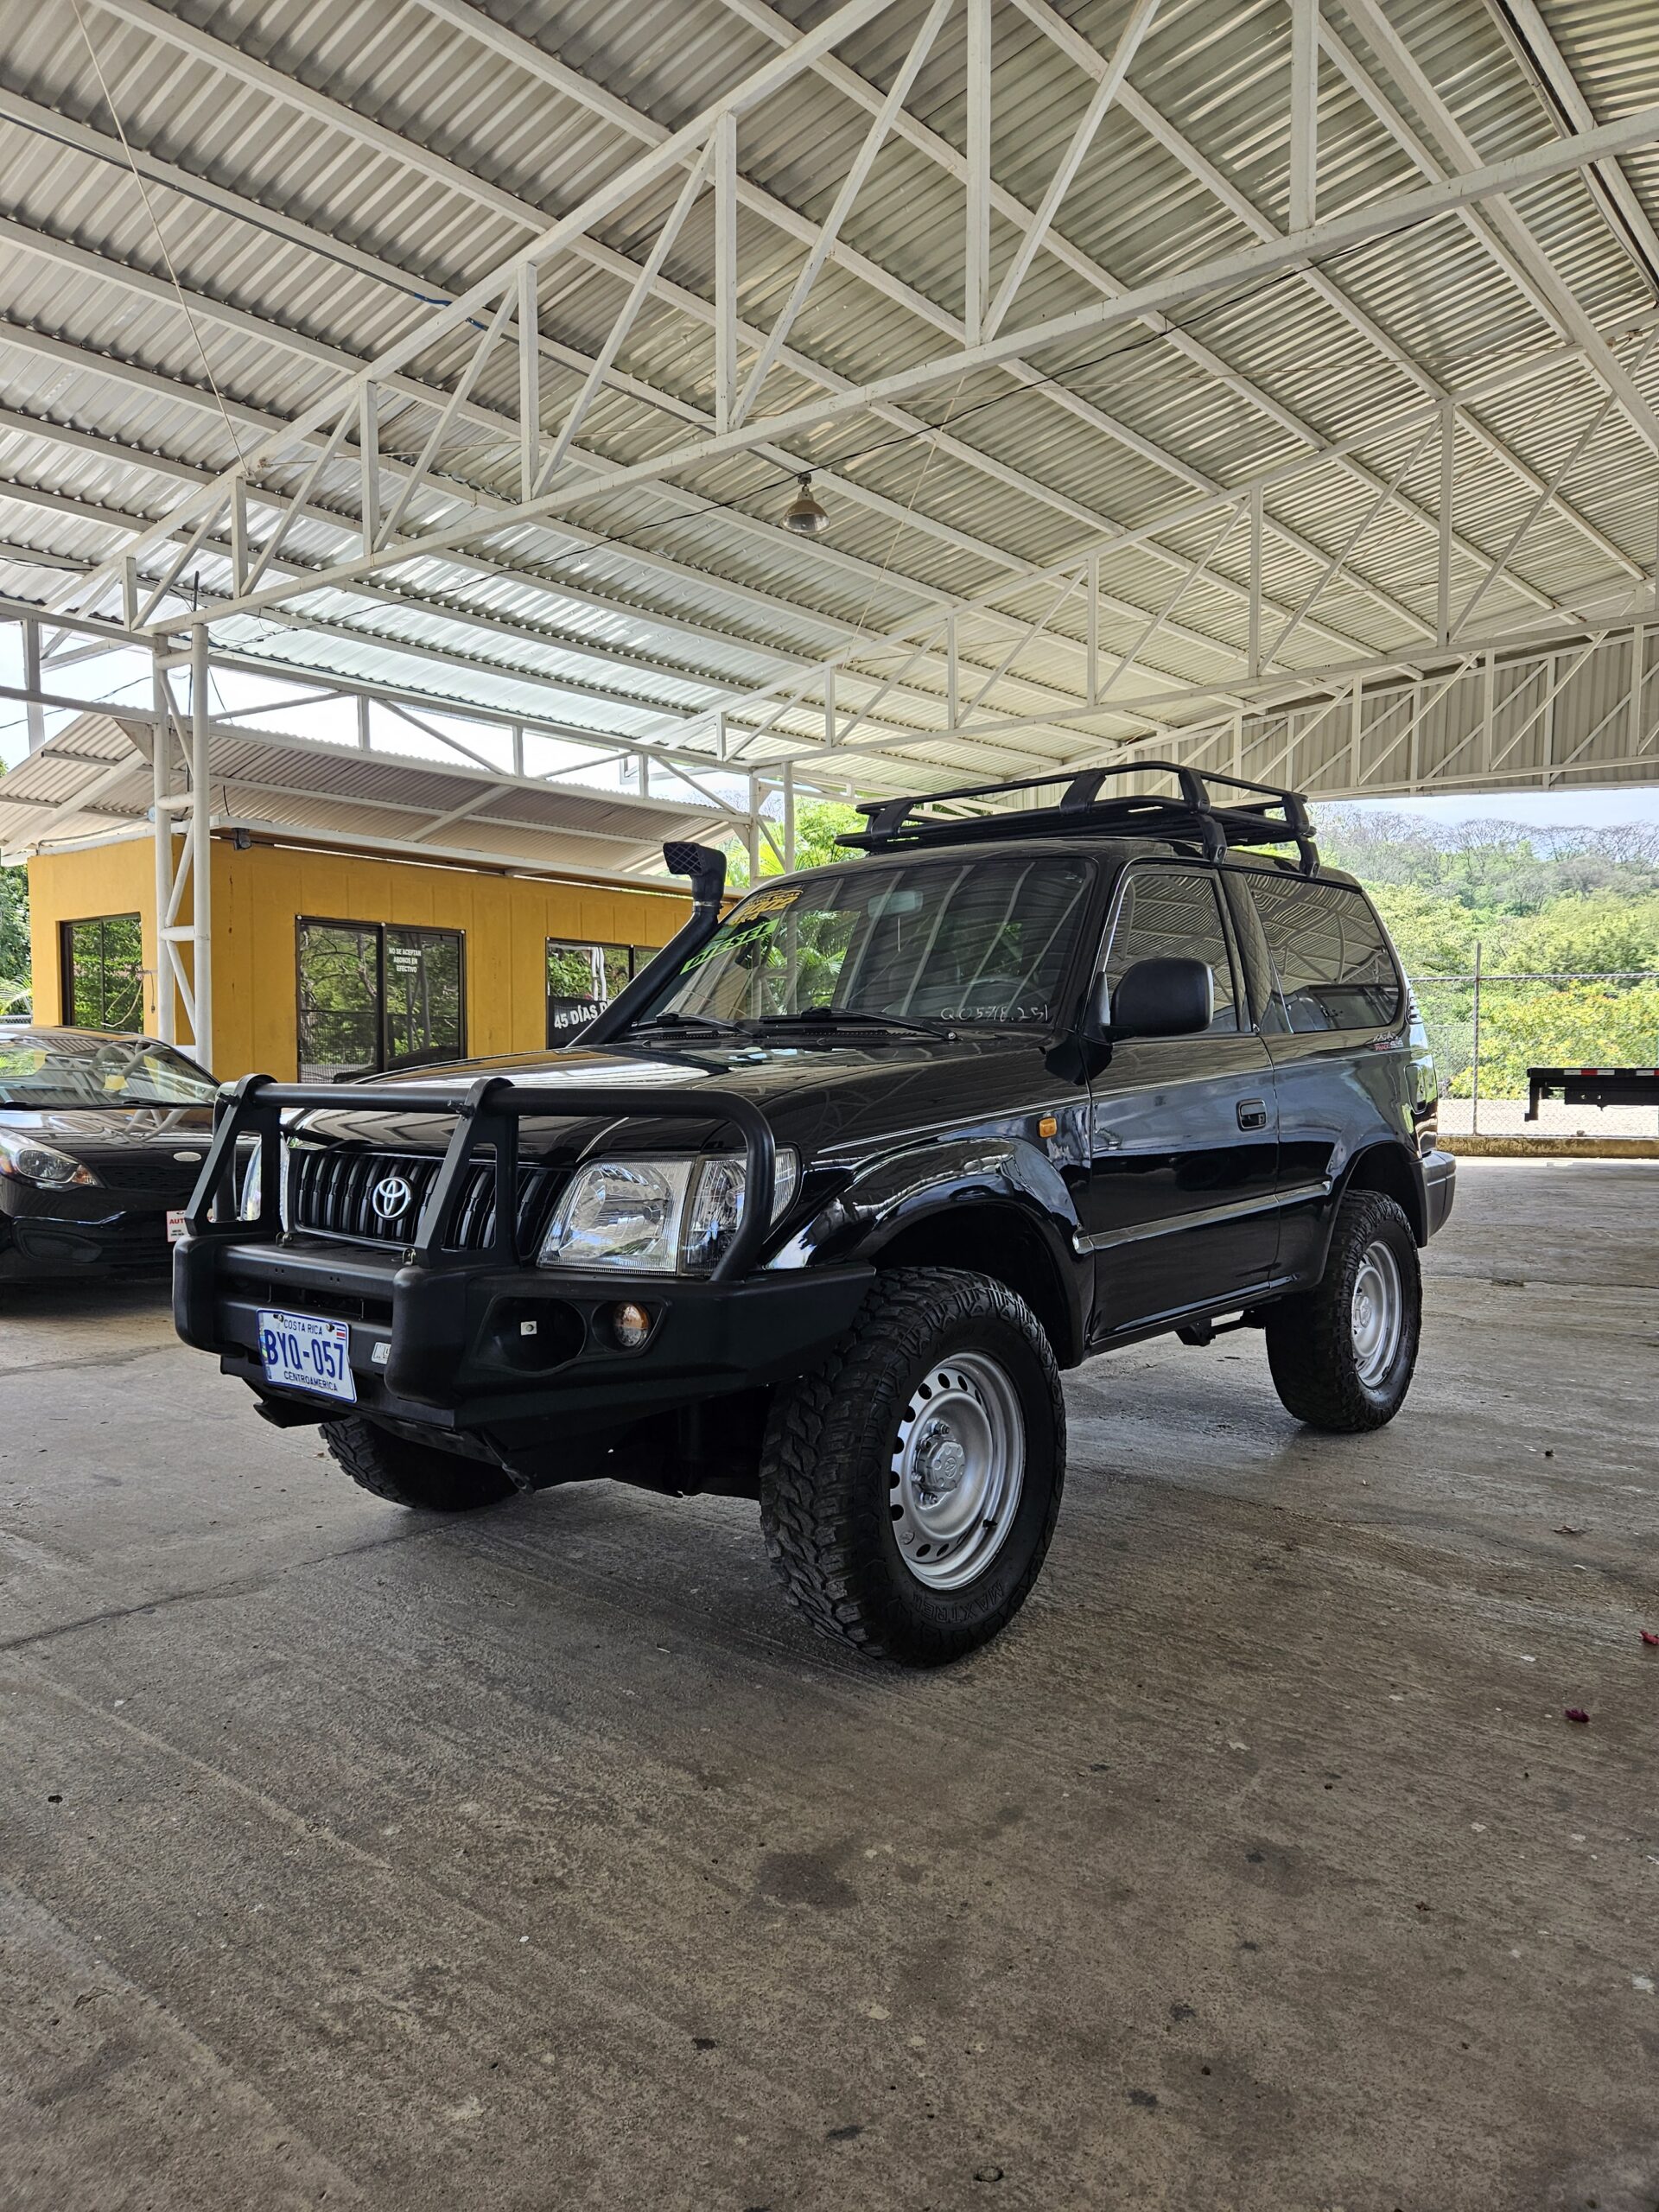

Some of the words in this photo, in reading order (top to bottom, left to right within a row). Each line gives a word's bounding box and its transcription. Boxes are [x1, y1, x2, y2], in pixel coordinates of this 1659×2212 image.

[688, 922, 772, 969] DIESEL
[554, 1013, 569, 1029] 45
[570, 1005, 598, 1025] DÍAS
[283, 1319, 306, 1332] COSTA
[307, 1323, 323, 1337] RICA
[264, 1329, 344, 1381] BYQ-057
[283, 1370, 339, 1392] CENTROAMERICA
